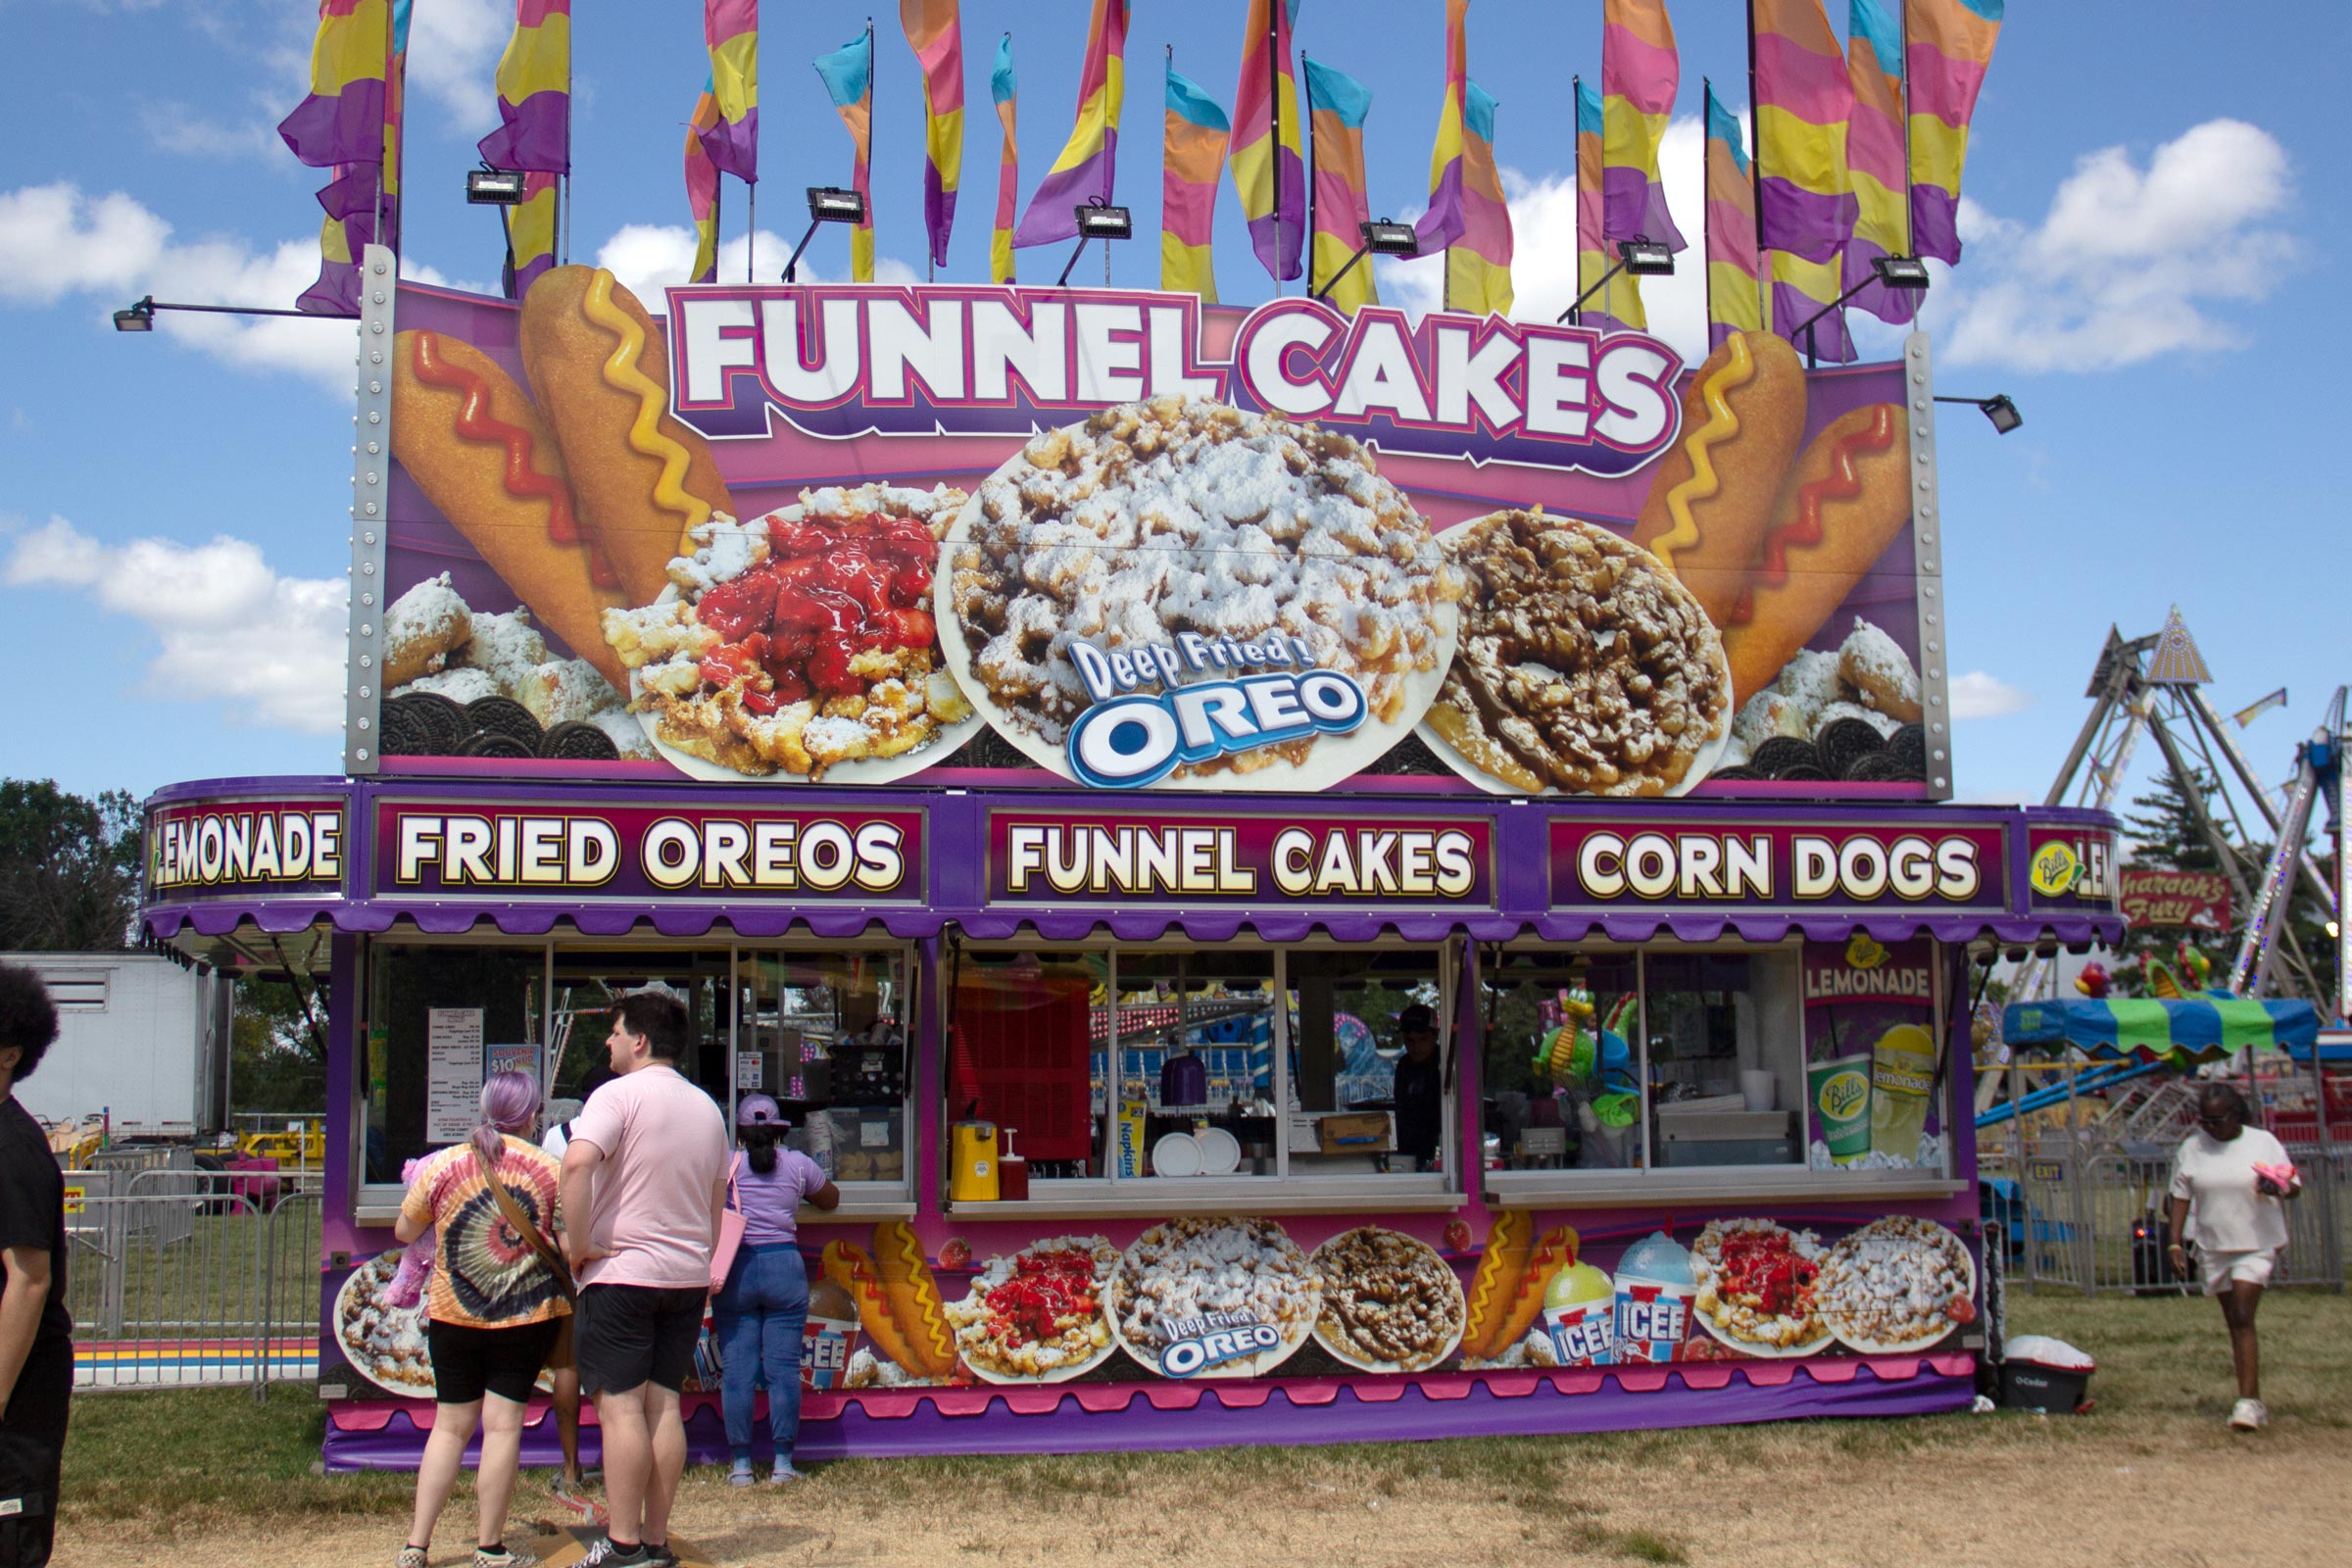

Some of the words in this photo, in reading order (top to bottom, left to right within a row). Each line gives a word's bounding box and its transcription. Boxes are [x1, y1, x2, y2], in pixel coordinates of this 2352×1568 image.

[676, 295, 1225, 409] FUNNEL
[1239, 307, 1676, 447] CAKES
[1068, 641, 1181, 704] Deep
[1070, 670, 1365, 787] OREO
[155, 810, 342, 888] LEMONADE
[396, 812, 620, 886] FRIED
[641, 816, 905, 891] OREOS
[1007, 824, 1256, 894] FUNNEL
[1271, 827, 1475, 897] CAKES
[1577, 831, 1773, 899] CORN
[1792, 835, 1980, 901] DOGS
[2120, 872, 2226, 904] haraoh's
[2124, 899, 2192, 923] Fury
[1806, 968, 1931, 998] LEMONADE
[491, 1058, 514, 1074] $10
[1873, 1071, 1933, 1091] lemonade
[1120, 1122, 1136, 1177] Napkins
[1161, 1317, 1206, 1342] Deep
[1620, 1300, 1685, 1341] ICEE
[800, 1335, 848, 1370] CEE
[1162, 1323, 1280, 1377] OREO
